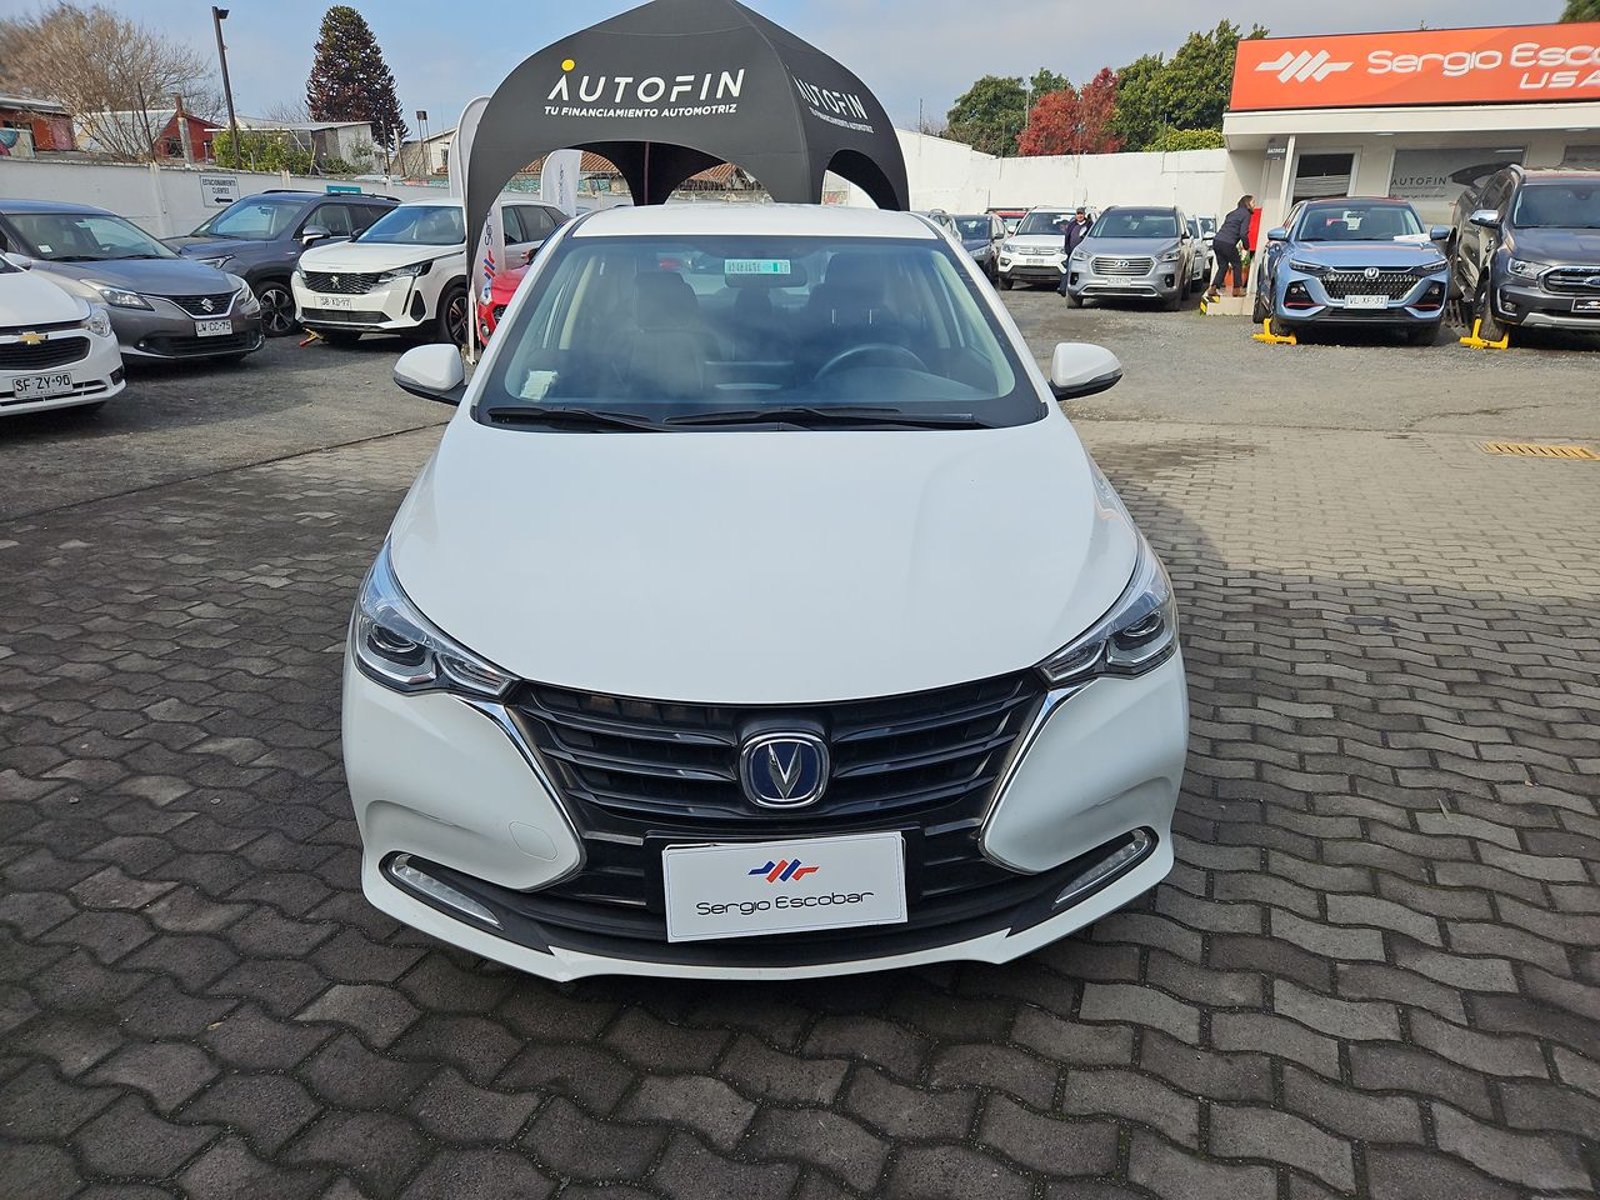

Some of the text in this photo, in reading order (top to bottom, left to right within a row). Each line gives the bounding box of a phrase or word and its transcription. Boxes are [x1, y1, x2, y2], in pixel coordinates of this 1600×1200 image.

[1367, 50, 1502, 76] Sergio
[548, 68, 745, 103] AUTOFIN
[545, 104, 737, 117] TU FINANCIAMIENTO AUTOMOTRIZ
[1391, 176, 1447, 185] AUTOFIN
[696, 891, 875, 915] Sergio Escobar
